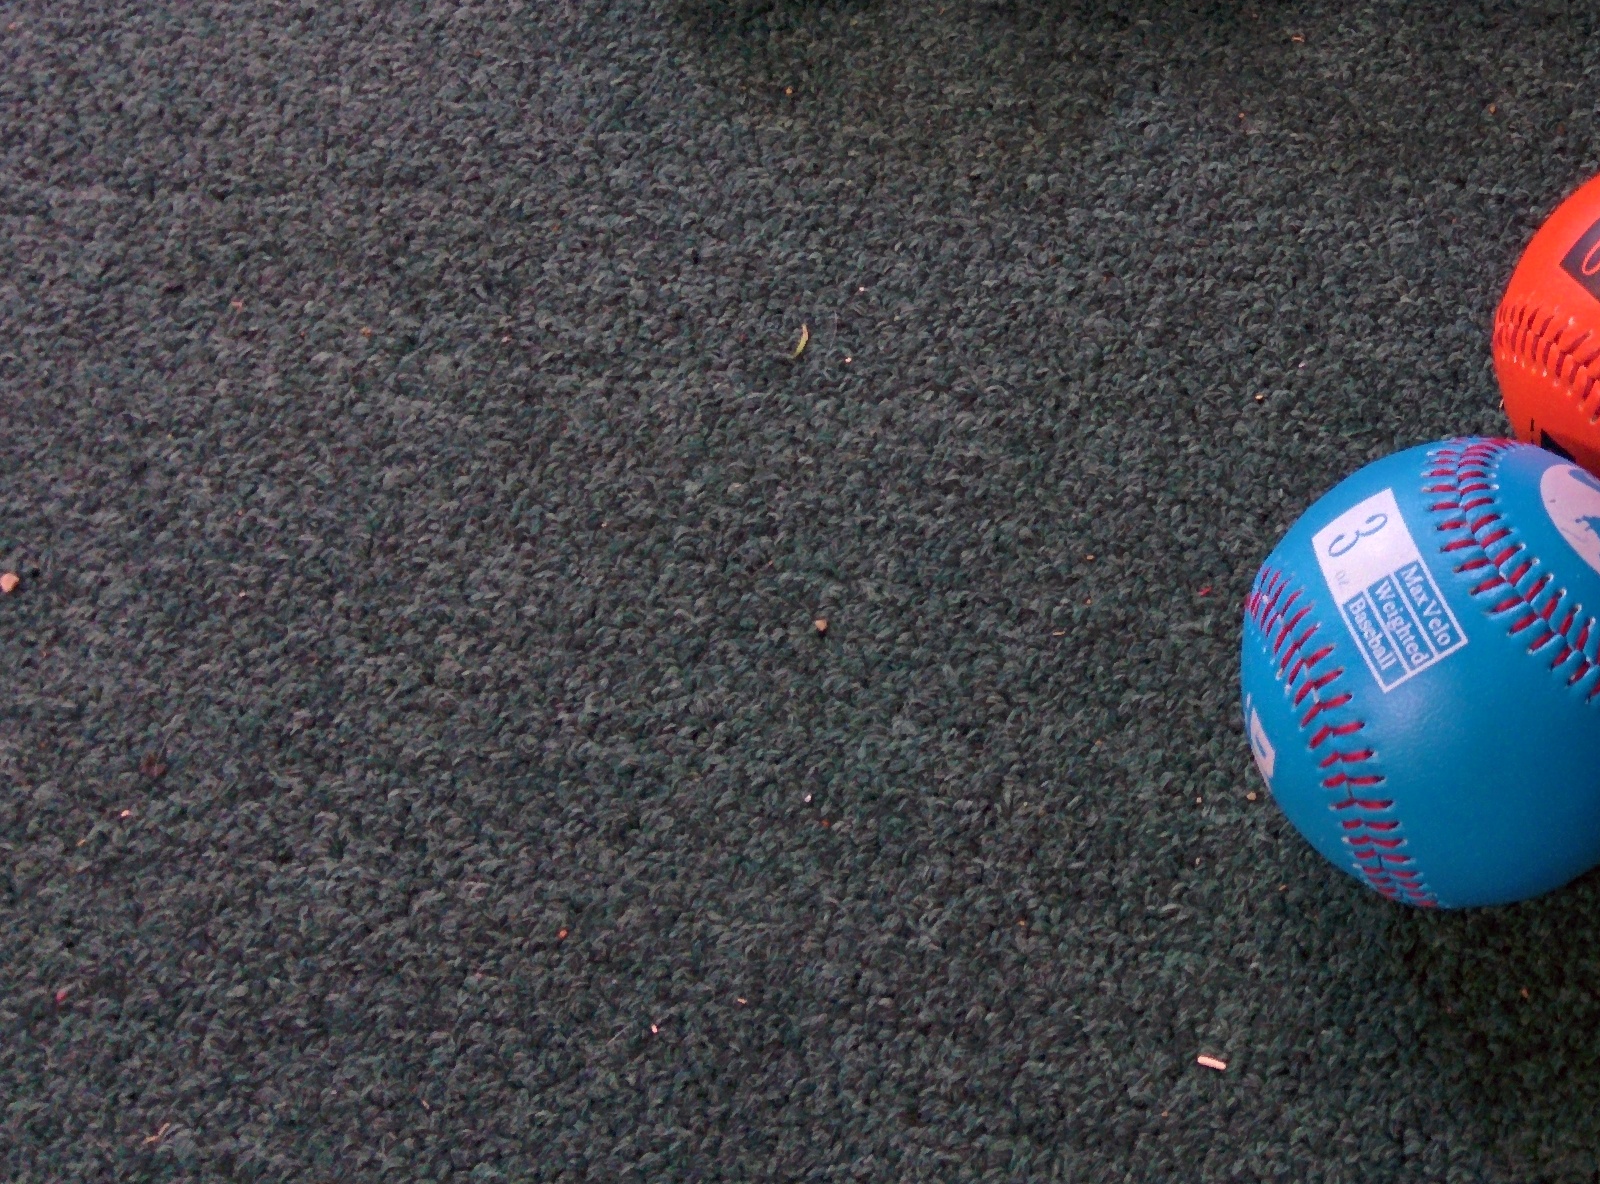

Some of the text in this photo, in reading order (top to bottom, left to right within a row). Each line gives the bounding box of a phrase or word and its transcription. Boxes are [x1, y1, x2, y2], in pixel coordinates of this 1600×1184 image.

[1328, 513, 1389, 558] 3
[1350, 594, 1397, 671] Baseball
[1375, 579, 1430, 667] Weighted
